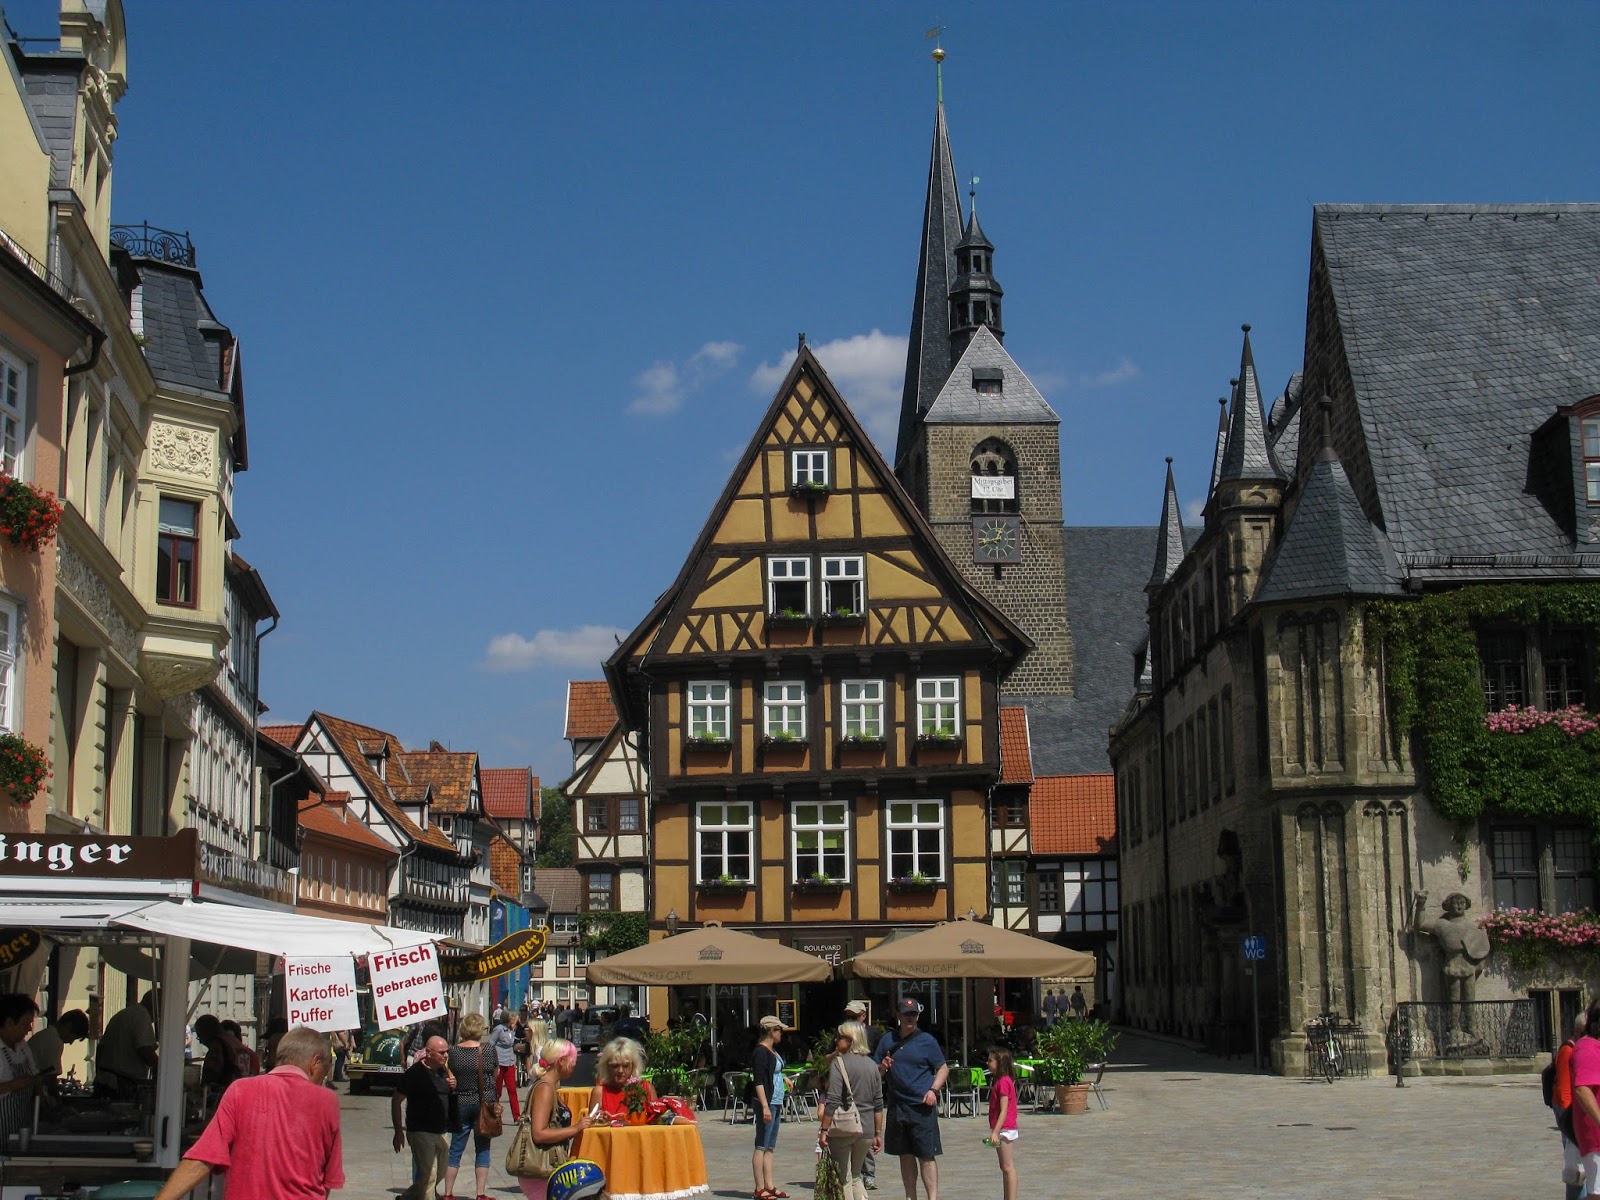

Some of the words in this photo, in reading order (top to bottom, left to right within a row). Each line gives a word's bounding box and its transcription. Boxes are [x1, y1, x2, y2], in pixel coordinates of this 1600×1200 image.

[373, 946, 431, 972] Frisch
[464, 934, 540, 975] Thüringer
[1245, 949, 1265, 959] WC
[288, 963, 331, 976] Frische
[600, 971, 663, 981] BOULEVARD
[863, 964, 930, 975] BOULEVARD
[290, 983, 354, 1002] Kartoffel-
[376, 972, 438, 997] gebratene
[291, 1008, 333, 1023] Puffer
[384, 997, 438, 1021] Leber
